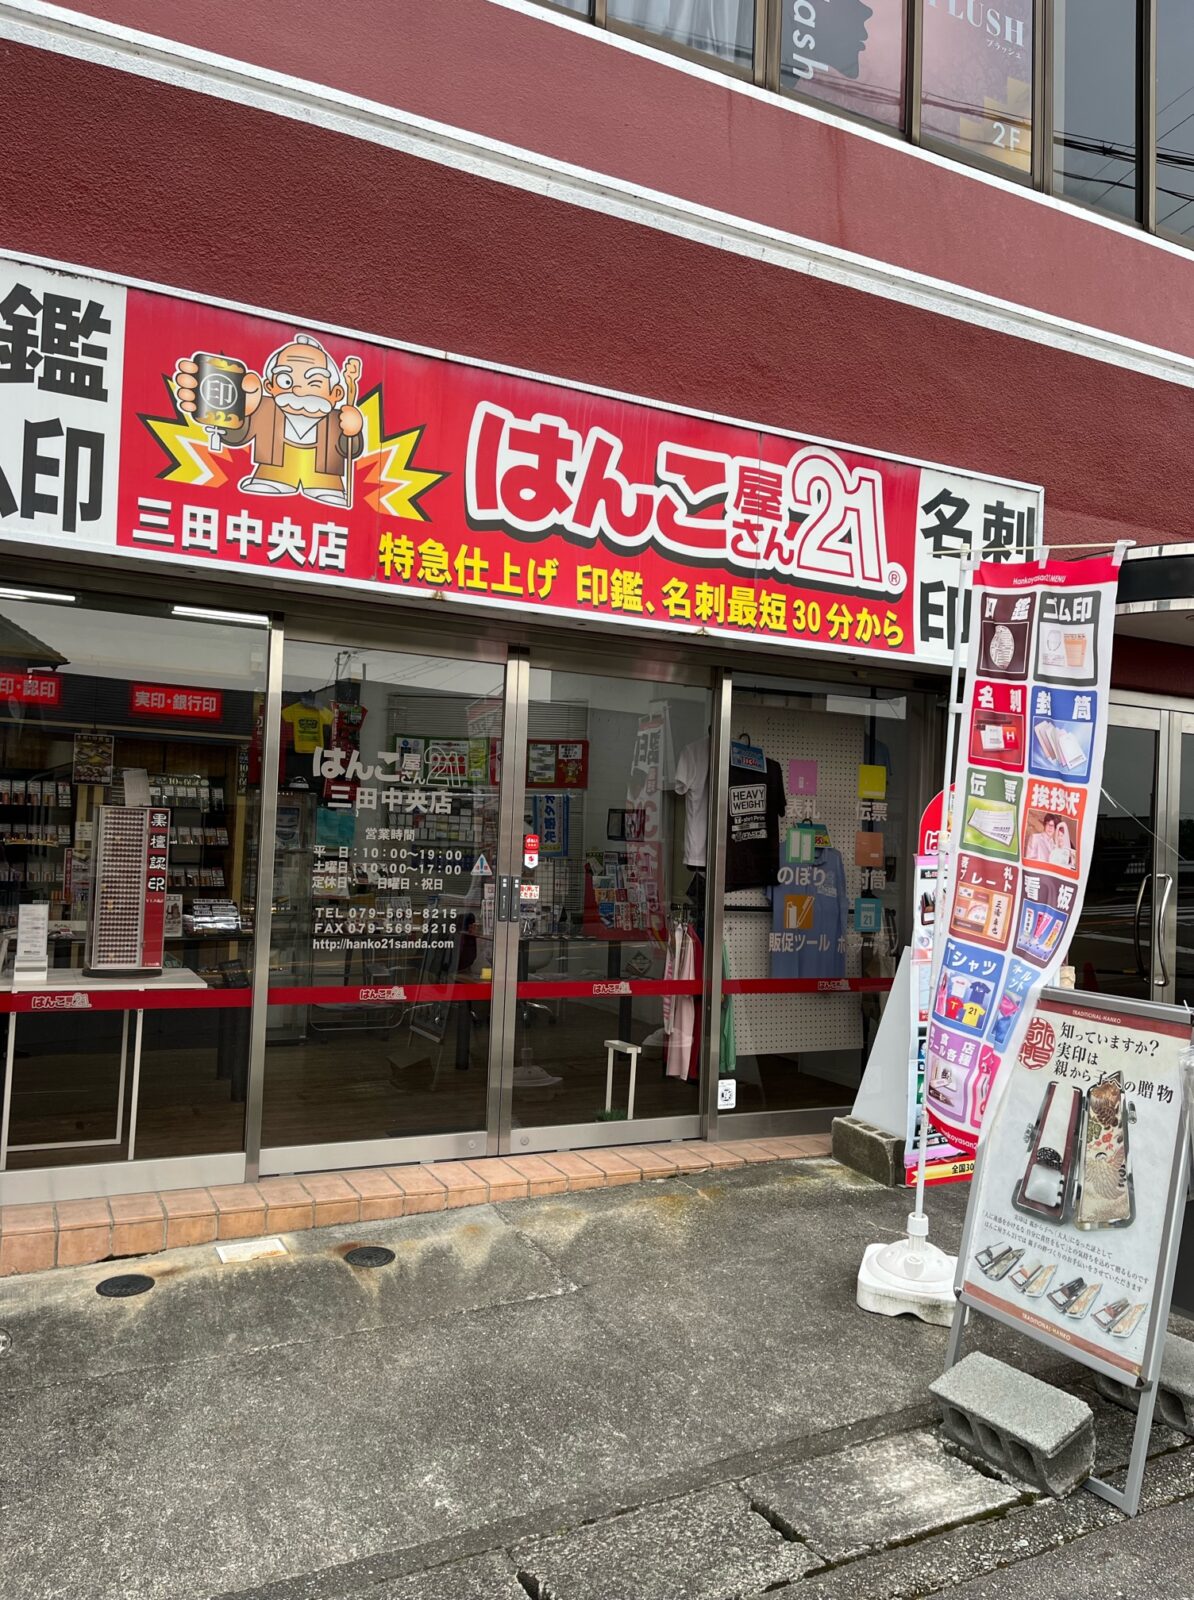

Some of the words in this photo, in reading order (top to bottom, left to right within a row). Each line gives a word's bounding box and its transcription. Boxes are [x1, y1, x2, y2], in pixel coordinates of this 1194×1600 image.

[929, 0, 1025, 48] LUSH
[792, 0, 830, 81] ash
[992, 121, 1021, 152] 2F
[0, 283, 112, 402] 鑑
[204, 377, 235, 407] 印
[132, 497, 349, 570] 三田中央店
[920, 487, 1036, 563] 名刺
[379, 532, 560, 597] 特急仕上げ
[1043, 596, 1094, 623] ゴム印
[135, 690, 217, 714] 実印・銀行印
[977, 685, 1023, 714] 名刺
[1035, 690, 1093, 722] 封筒
[327, 785, 453, 815] 三田中央店
[732, 789, 765, 802] HEAVY
[970, 771, 1018, 803] 伝票
[1031, 783, 1081, 817] 挨拶状
[732, 800, 765, 811] WEIGHT
[786, 799, 821, 819] 表札
[855, 800, 889, 822] 伝票
[365, 828, 415, 842] 営業時間
[147, 812, 168, 892] 黒檀認印
[776, 866, 827, 887] のぼり
[1024, 875, 1070, 912] 看板
[315, 908, 344, 919] TEL
[349, 908, 458, 920] 079-569-8215
[315, 923, 344, 934] FAX
[349, 923, 457, 934] 079-569-8216
[312, 938, 455, 951] http://hanko21sanda.com
[768, 932, 831, 953] 販促ツール
[968, 1006, 979, 1016] 21
[1059, 1021, 1160, 1057] 知っていますか?
[1057, 1042, 1099, 1066] 実印は
